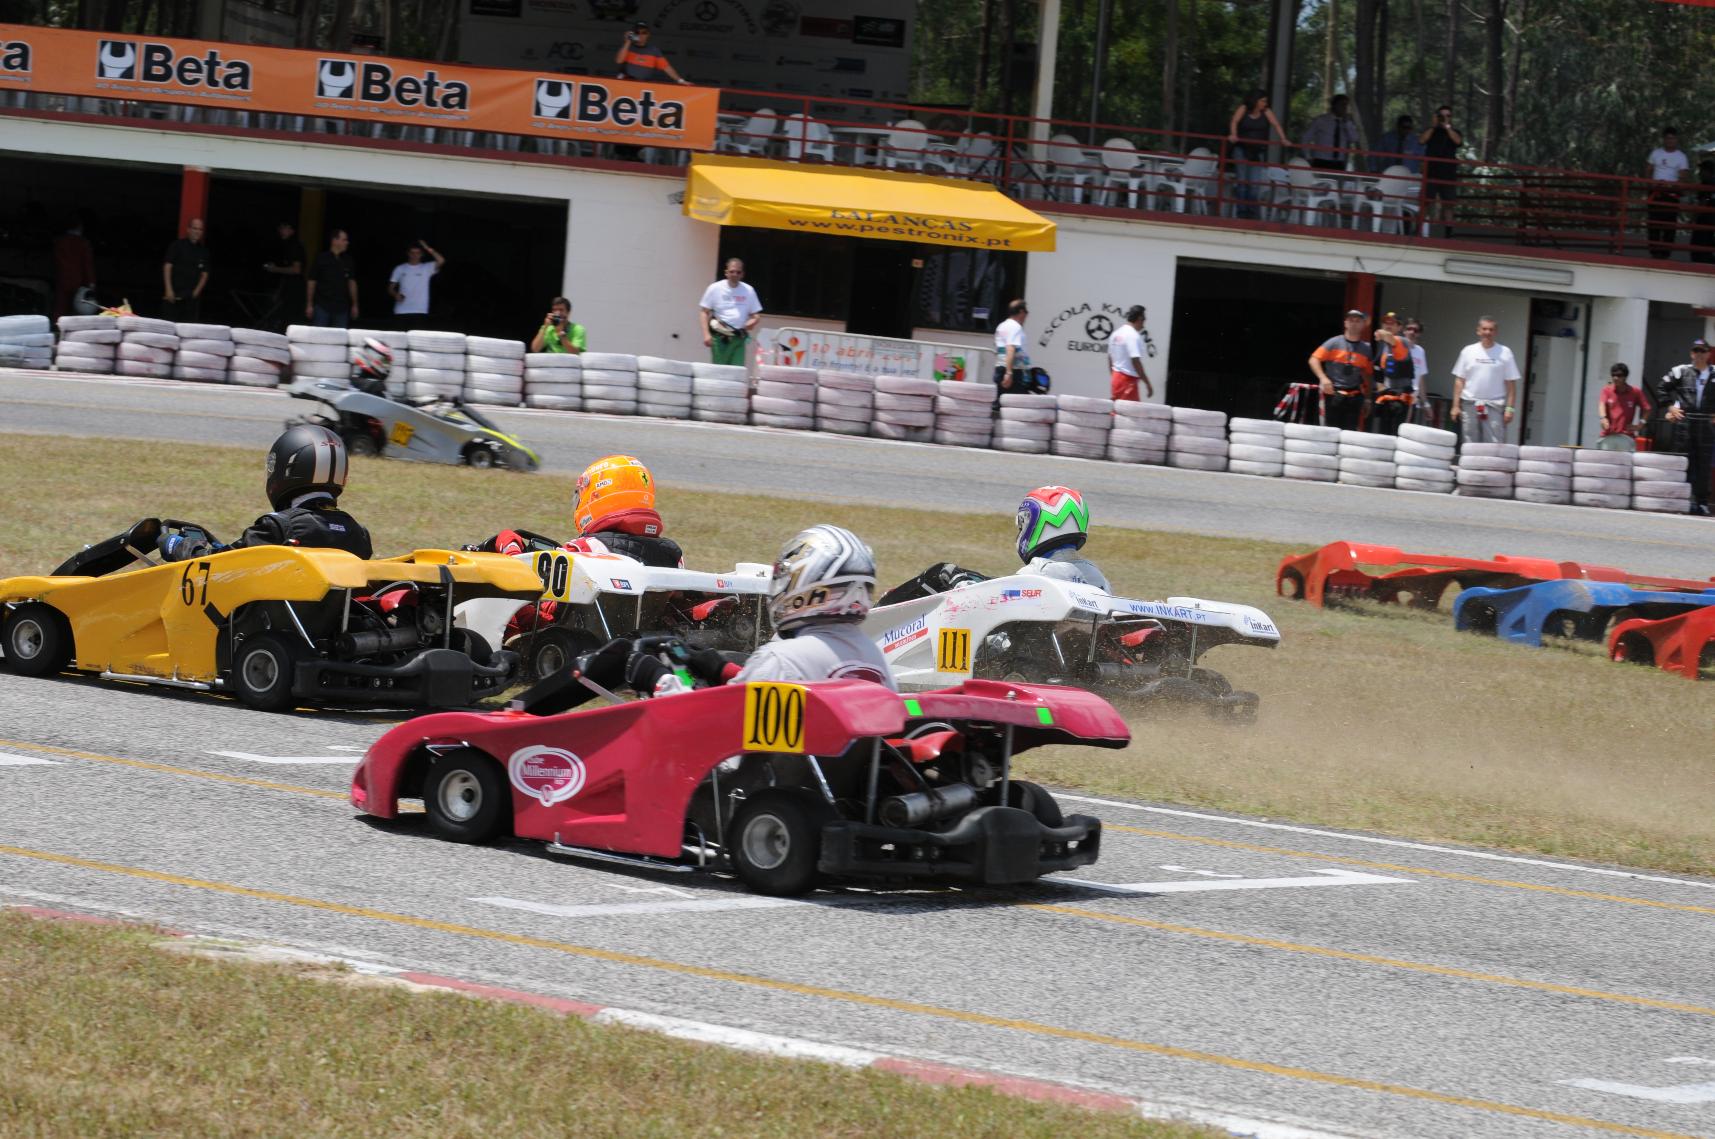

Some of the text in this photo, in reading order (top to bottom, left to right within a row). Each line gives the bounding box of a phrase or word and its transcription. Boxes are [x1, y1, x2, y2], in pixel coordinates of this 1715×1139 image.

[142, 43, 251, 90] Beta
[361, 62, 468, 110] Beta
[577, 84, 684, 130] Beta
[788, 217, 1011, 247] www.pestronix.pt
[1038, 302, 1092, 349] ESCOLA
[181, 561, 211, 607] 67
[537, 552, 569, 598] 90
[1021, 589, 1042, 598] SEUR
[884, 613, 927, 645] Mucoral
[940, 630, 968, 671] 111
[749, 686, 802, 748] 100
